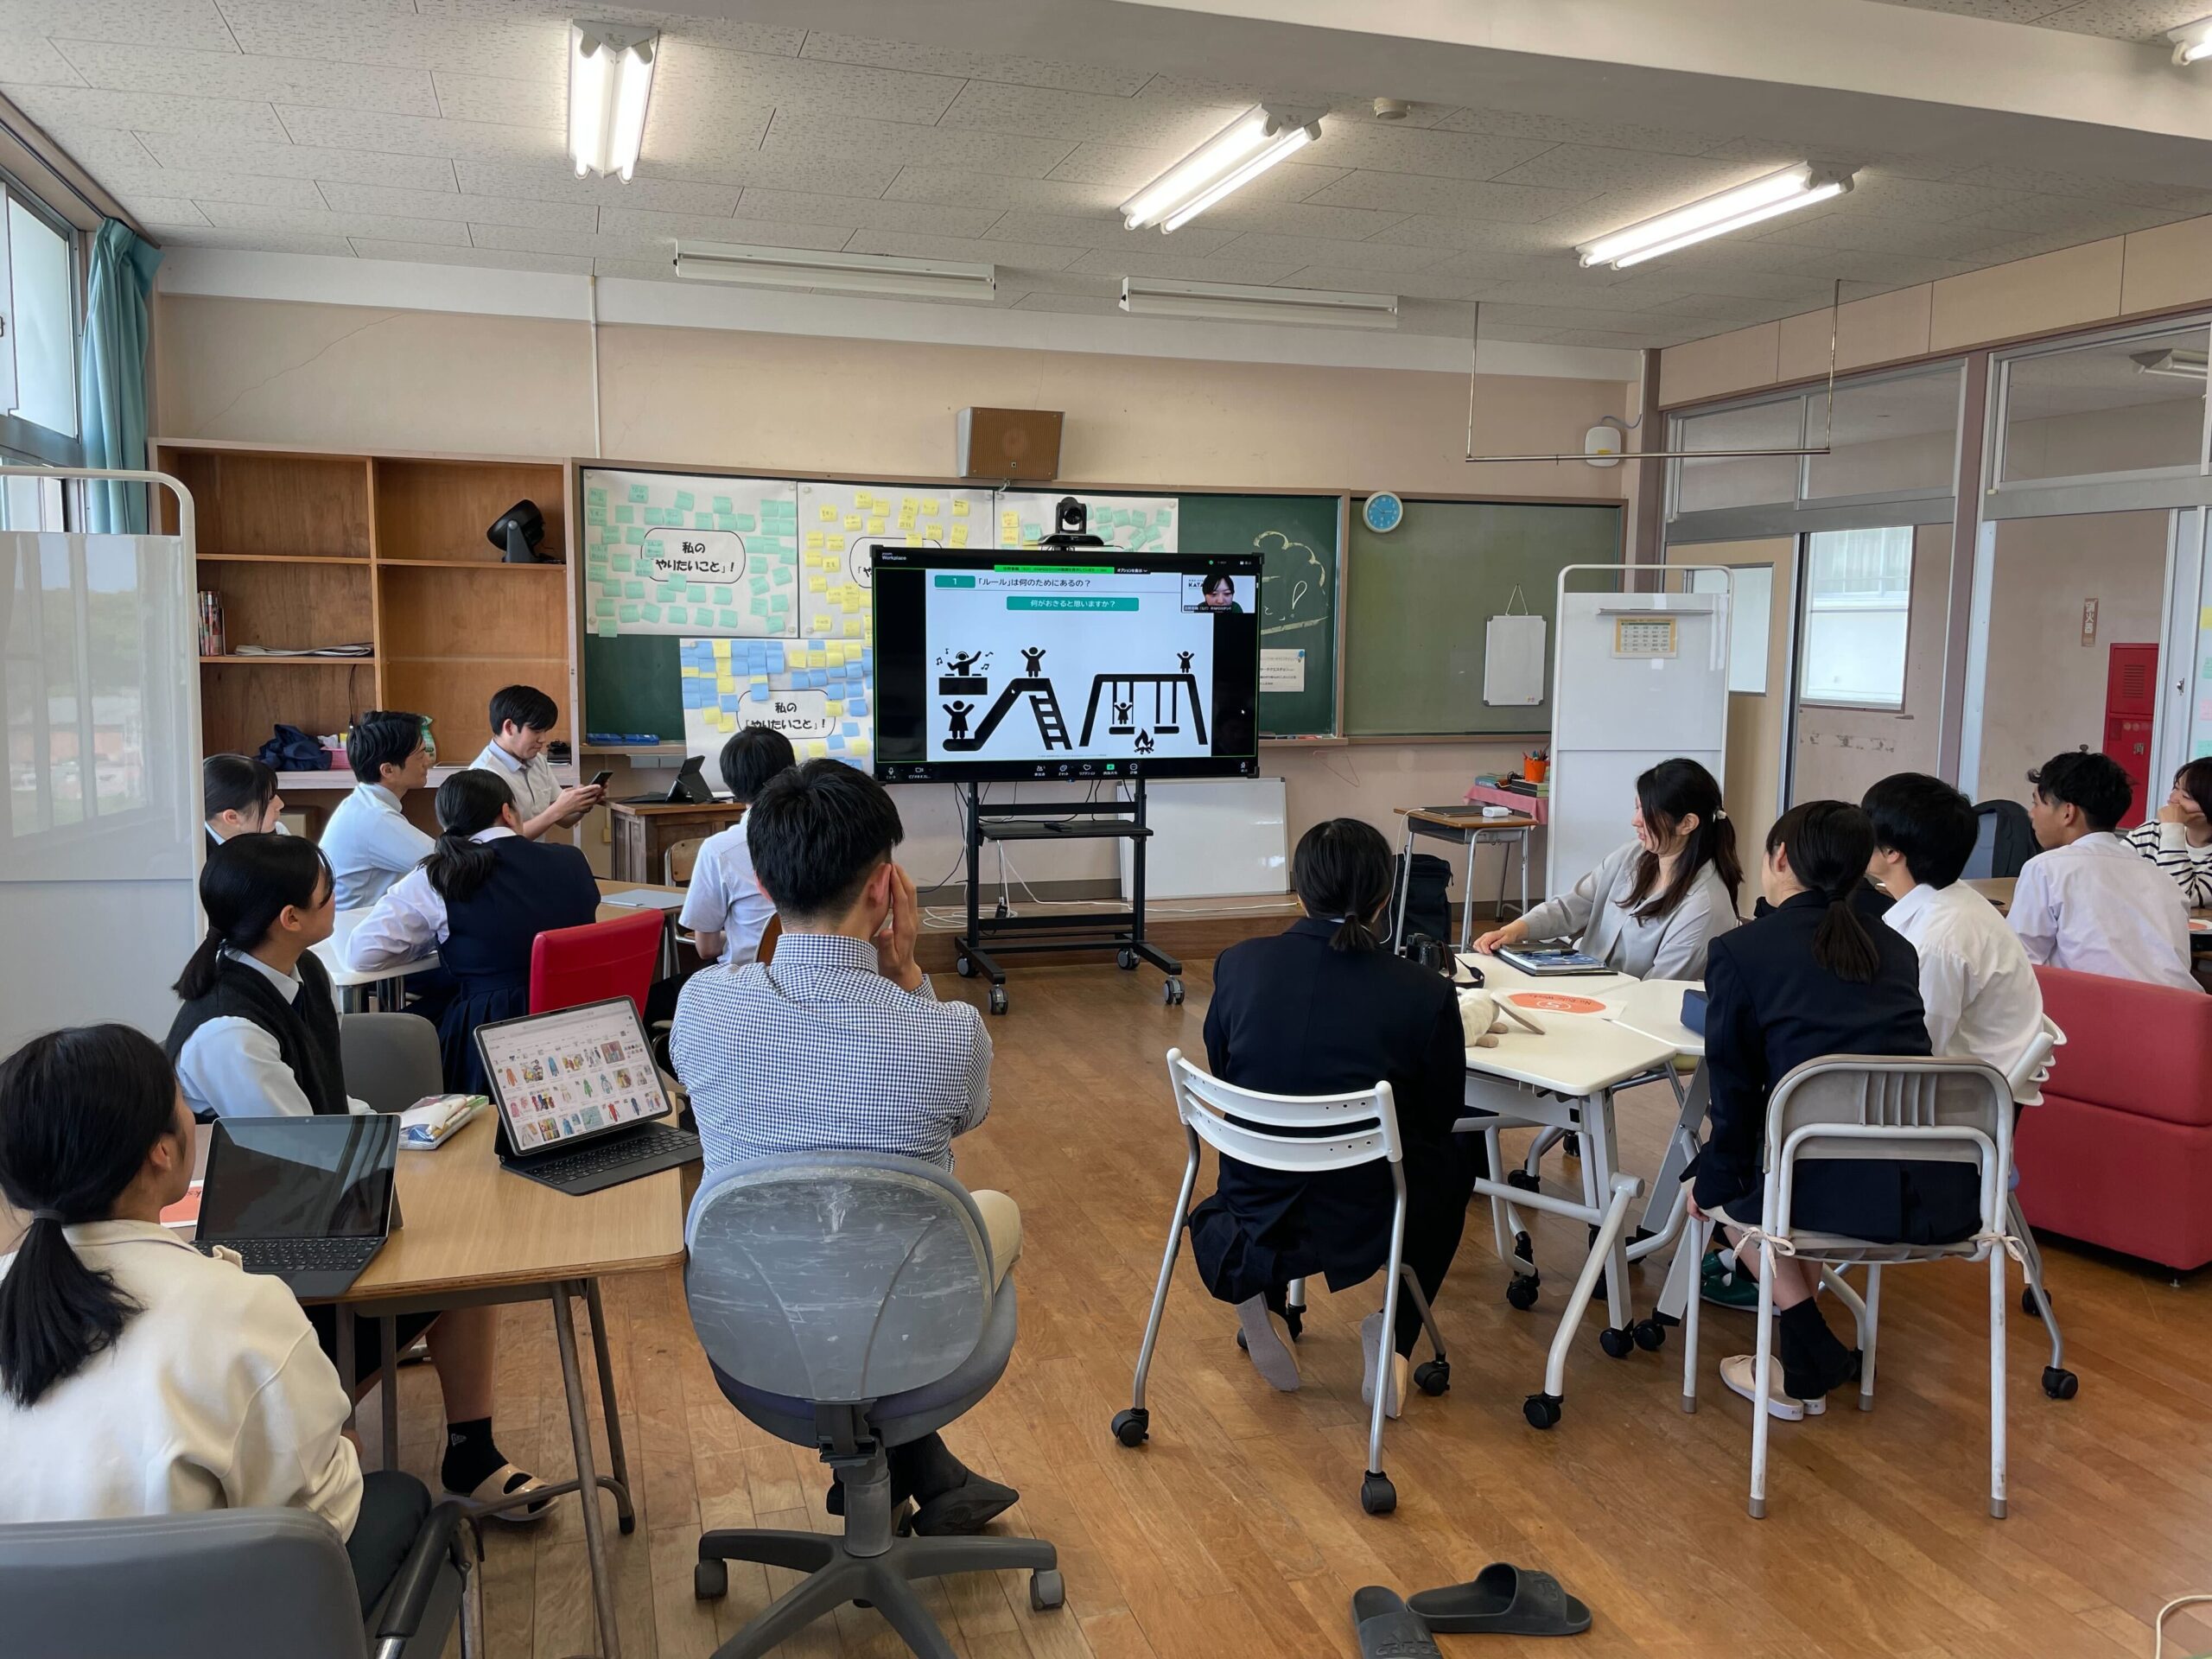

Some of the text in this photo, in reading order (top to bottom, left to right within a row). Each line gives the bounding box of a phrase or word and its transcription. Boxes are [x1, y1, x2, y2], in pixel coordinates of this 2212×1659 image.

[682, 541, 706, 554] 私の
[952, 577, 957, 586] 1
[1030, 599, 1116, 608] 何がおきると思いますか？
[774, 702, 797, 714] 私の
